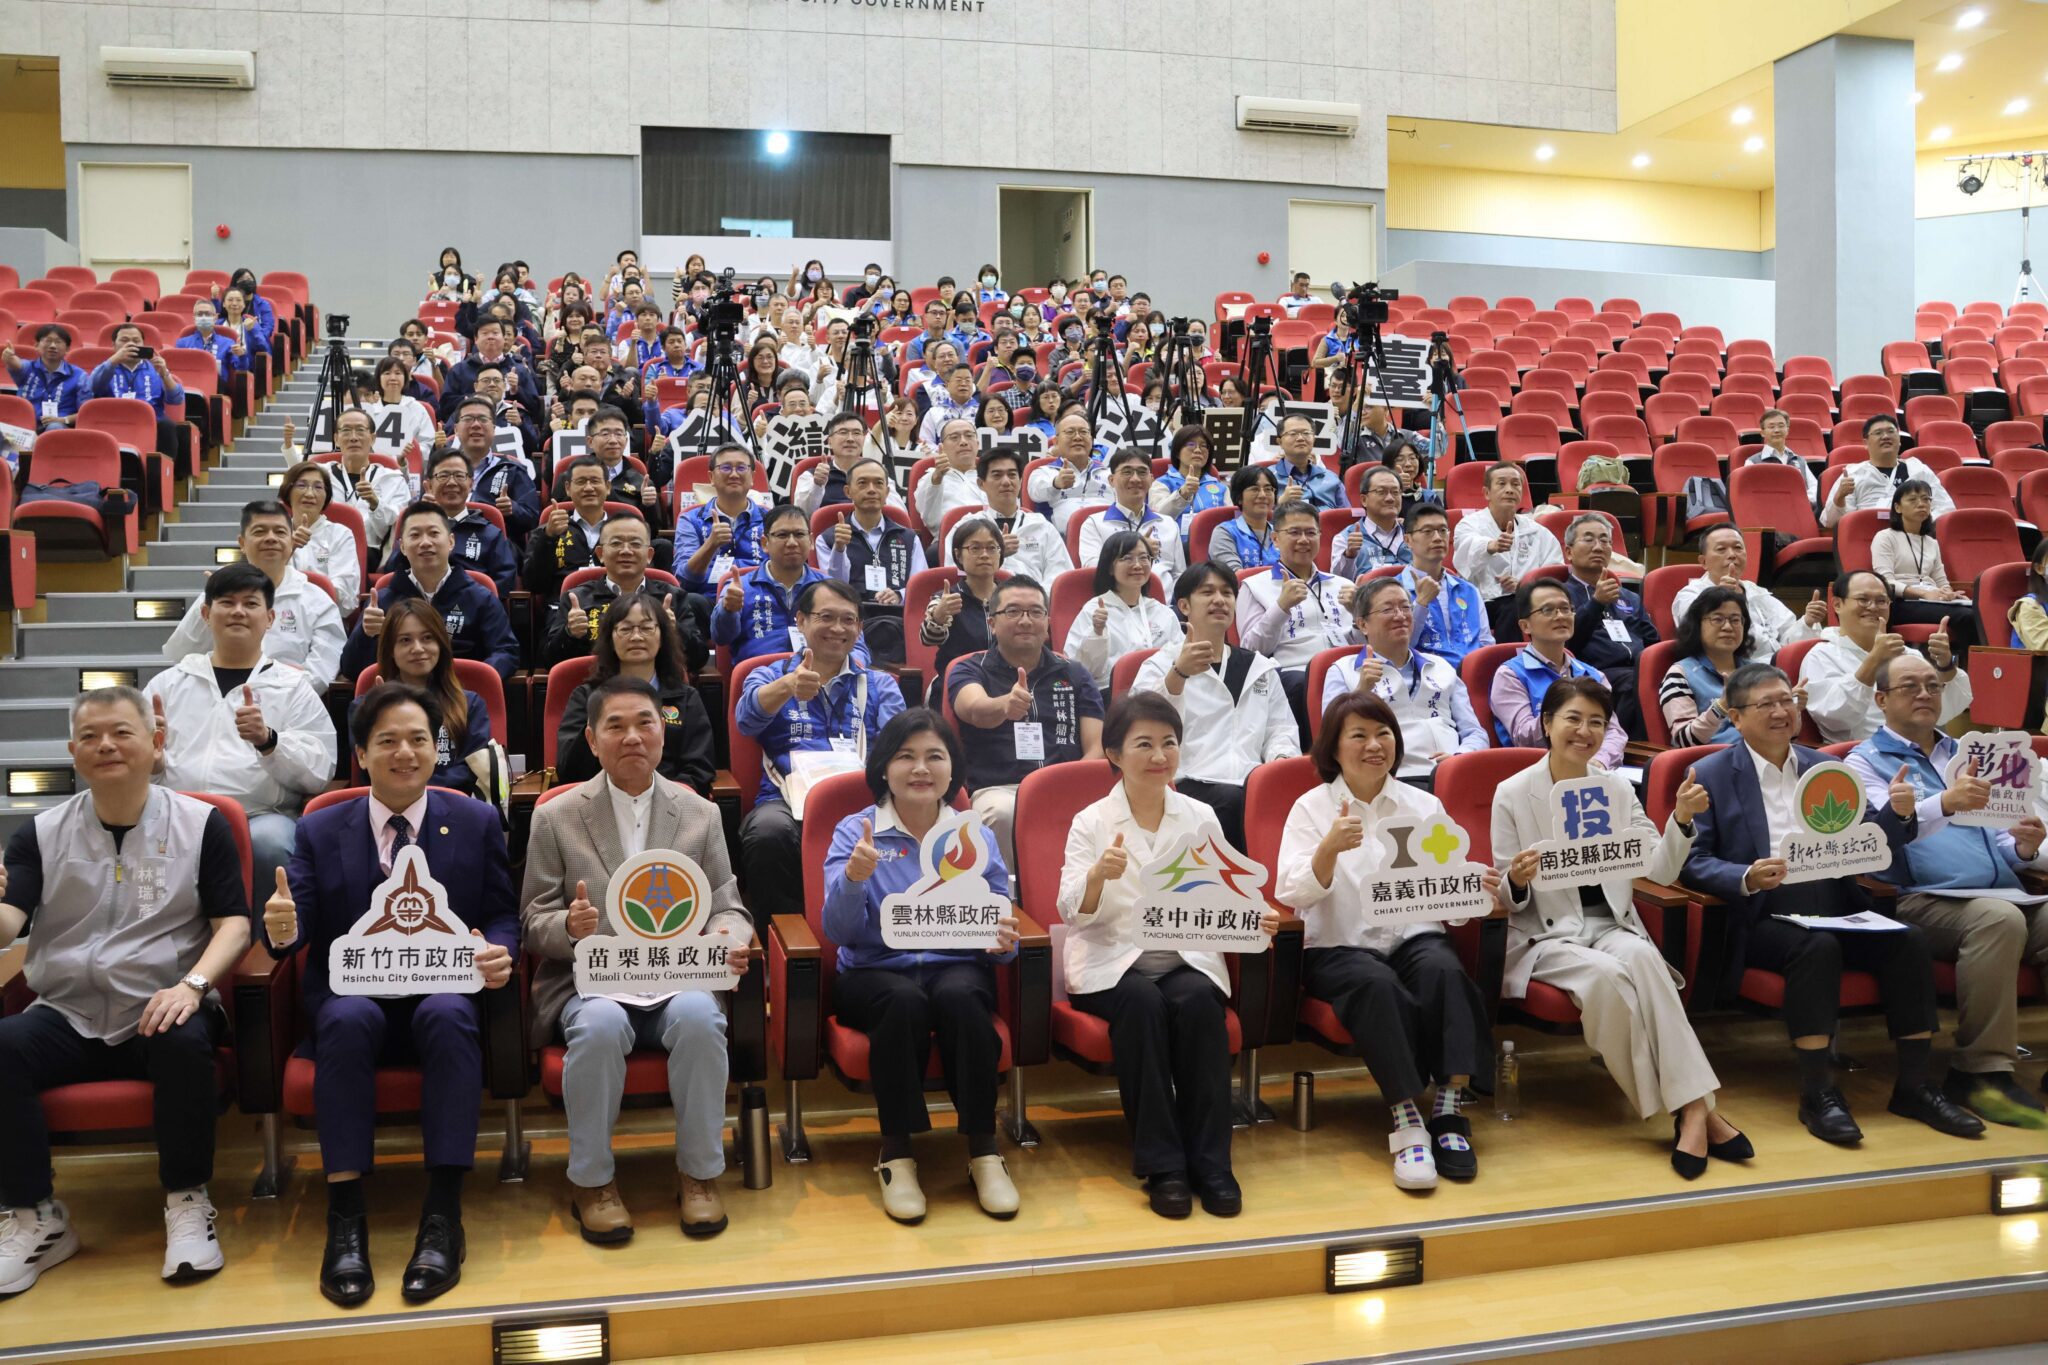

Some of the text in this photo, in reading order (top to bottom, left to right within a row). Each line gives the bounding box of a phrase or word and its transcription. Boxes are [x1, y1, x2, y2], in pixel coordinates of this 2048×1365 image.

[1540, 838, 1642, 872] 南投縣政府
[1787, 832, 1878, 864] 新竹縣政府
[1541, 861, 1644, 882] Nantou County Government
[1816, 860, 1840, 870] County
[1841, 854, 1884, 867] Government
[1371, 872, 1483, 903] 嘉義市政府
[891, 904, 1001, 926] 雲林縣政府
[1374, 898, 1485, 916] CHIAYI CITY GOVERNMENT
[1142, 906, 1262, 931] 臺中市政府
[893, 930, 920, 938] YUNLIN
[921, 930, 950, 938] COUNTY
[1142, 931, 1261, 942] TAICHUNG CITY GOVERNMENT
[342, 946, 475, 970] 新竹市政府
[587, 945, 729, 970] 苗栗縣政府
[342, 973, 473, 984] Hsinchu City Government
[589, 970, 728, 982] Miaoli County Government
